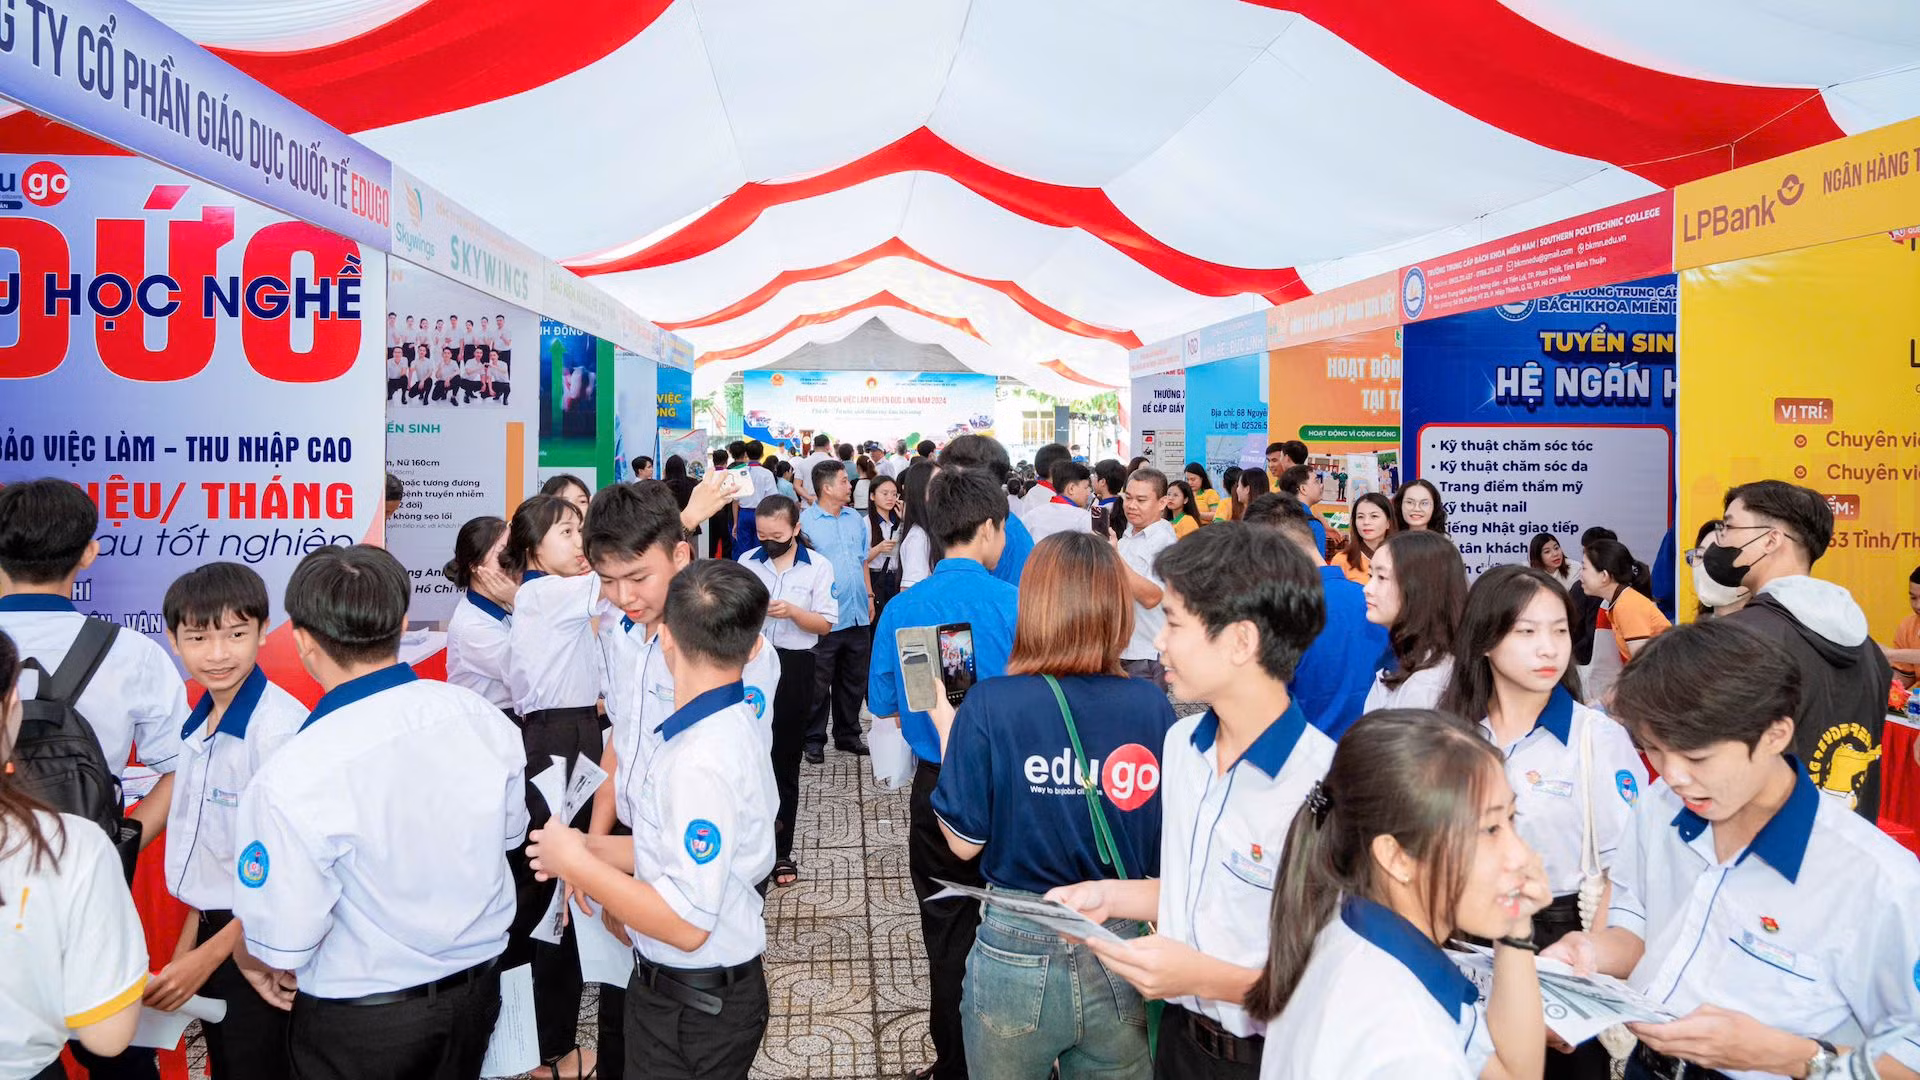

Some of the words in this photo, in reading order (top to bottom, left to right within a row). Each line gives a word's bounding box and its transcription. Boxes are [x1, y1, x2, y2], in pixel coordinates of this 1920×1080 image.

[27, 0, 68, 77] TY
[77, 14, 117, 101] CỔ
[123, 49, 191, 138] PHẦN
[198, 91, 244, 162] GIÁO
[249, 118, 284, 185] DỤC
[288, 141, 329, 201] QUỐC
[331, 157, 350, 210] TẾ
[350, 172, 391, 229] EDUGO
[28, 173, 71, 200] go
[1684, 195, 1776, 243] LPBank
[1823, 162, 1862, 195] NGÂN
[1867, 152, 1909, 184] HÀNG
[395, 222, 435, 261] Skywings
[1446, 261, 1463, 272] TRUNG
[1474, 253, 1489, 265] BÁCH
[1489, 249, 1506, 261] KHOA
[1506, 243, 1521, 257] MIỀN
[1521, 239, 1537, 251] NAM
[1539, 229, 1575, 247] SOUTHERN
[1575, 217, 1624, 237] POLYTECHNIC
[1625, 207, 1661, 224] COLLEGE
[1514, 247, 1574, 268] bkmnedu@gmail.com
[1585, 234, 1627, 251] bkmn.edu.vn
[1589, 255, 1607, 267] Thuận
[450, 234, 528, 300] SKYWINGS
[44, 273, 181, 330] HỌC
[203, 254, 361, 319] NGHỀ
[1616, 286, 1656, 298] TRUNG
[1539, 295, 1581, 313] BÁCH
[1585, 299, 1628, 313] KHOA
[1632, 297, 1670, 314] MIỀN
[1540, 324, 1625, 353] TUYỂN
[1631, 333, 1675, 353] SIN
[1327, 357, 1367, 383] HOẠT
[1371, 353, 1401, 383] ĐỘN
[1497, 362, 1543, 404] HỆ
[1556, 361, 1650, 399] NGẮN
[1361, 389, 1386, 414] TẠI
[1781, 405, 1797, 422] VỊ
[1799, 401, 1828, 419] TRÍ:
[1236, 408, 1246, 417] 68
[408, 423, 441, 433] SINH
[1308, 430, 1327, 438] HOẠT
[1328, 429, 1349, 438] ĐỘNG
[1356, 429, 1376, 438] CỘNG
[0, 427, 34, 461] ẢO
[44, 430, 95, 467] VIỆC
[105, 430, 155, 461] LÀM
[186, 436, 229, 462] THU
[239, 432, 299, 467] NHẬP
[308, 437, 351, 463] CAO
[1440, 439, 1456, 453] Kỹ
[1461, 439, 1499, 453] thuật
[1502, 439, 1540, 451] chăm
[1544, 439, 1567, 451] sóc
[1571, 440, 1593, 452] tóc
[1826, 430, 1898, 451] Chuyên
[396, 459, 410, 467] Nữ
[412, 459, 440, 467] 160cm
[1440, 460, 1456, 474] Kỹ
[1461, 460, 1499, 474] thuật
[1502, 460, 1540, 472] chăm
[1544, 460, 1567, 472] sóc
[1571, 460, 1588, 472] da
[1827, 464, 1898, 484] Chuyên
[425, 490, 454, 499] truyền
[456, 489, 485, 498] nhiễm
[1440, 481, 1479, 496] Trang
[1484, 480, 1518, 493] điểm
[1522, 479, 1558, 493] thẩm
[1562, 481, 1583, 496] mỹ
[74, 475, 187, 528] IỆU/
[201, 475, 353, 520] THÁNG
[1461, 501, 1499, 515] thuật
[1502, 501, 1527, 513] nail
[1827, 496, 1854, 515] ỂM:
[393, 512, 422, 521] không
[1482, 521, 1515, 535] Nhật
[1519, 522, 1548, 536] giao
[1552, 520, 1579, 537] tiếp
[98, 534, 142, 556] au
[157, 524, 209, 556] tốt
[1459, 542, 1482, 553] tân
[1486, 542, 1528, 553] khách
[72, 578, 92, 601] HÍ
[415, 583, 432, 594] Hồ
[1024, 747, 1099, 786] edu
[1111, 761, 1160, 799] go
[1030, 786, 1046, 794] Way
